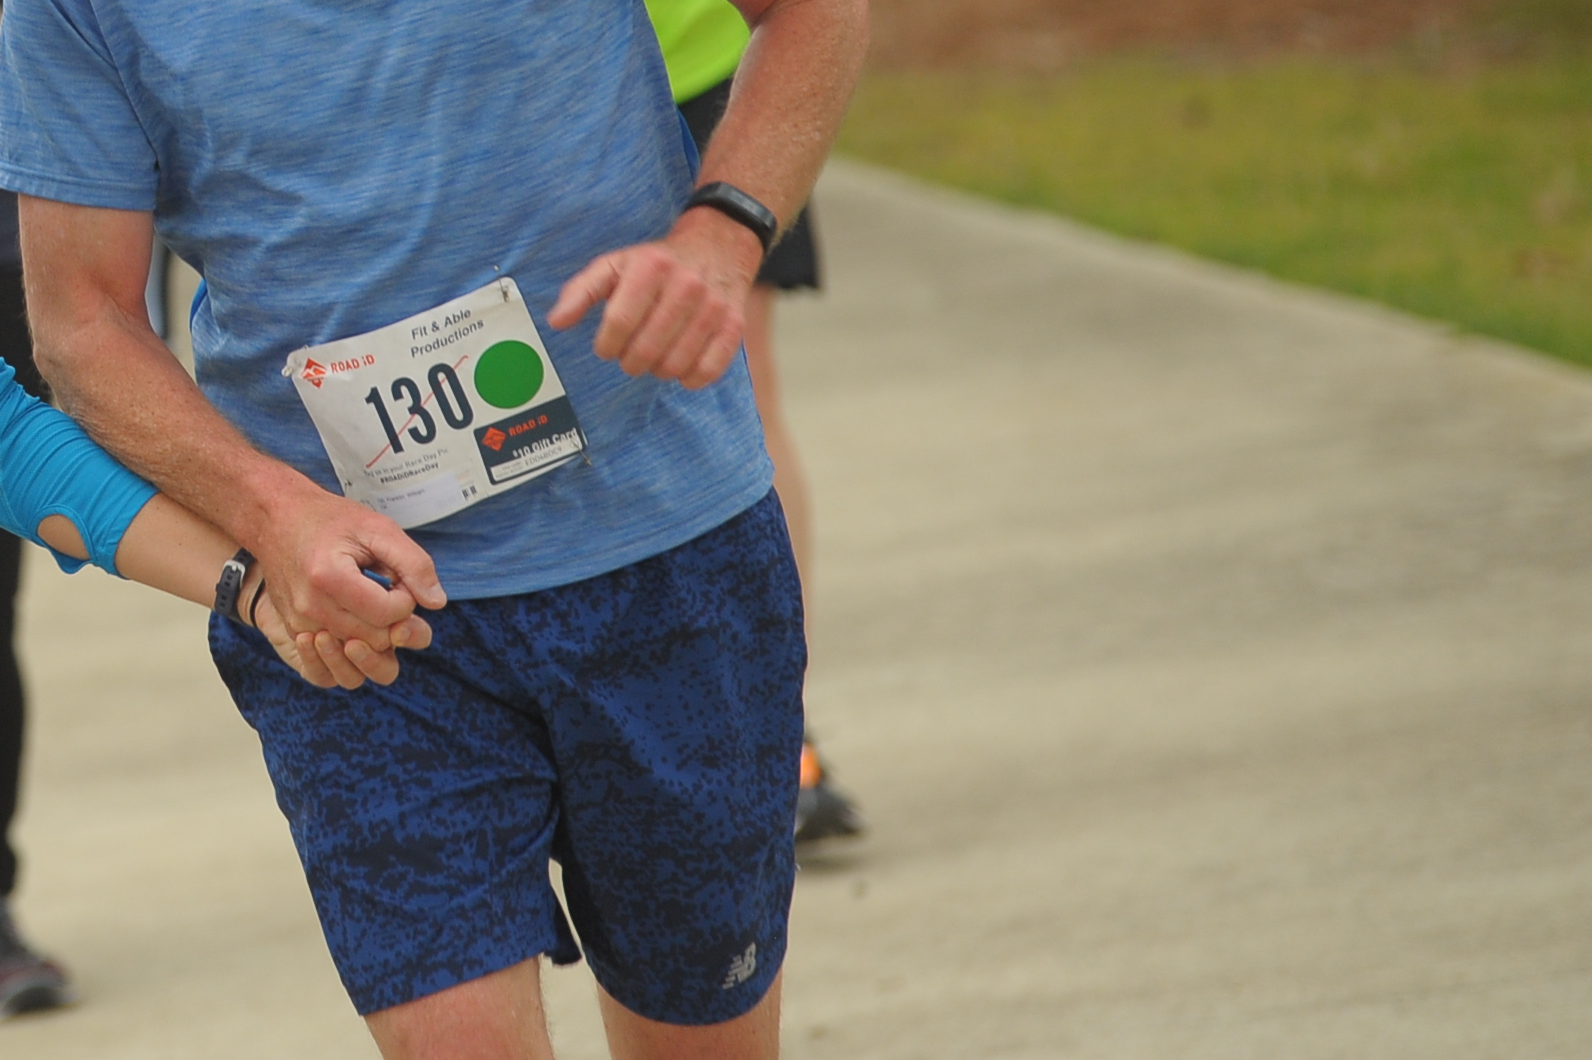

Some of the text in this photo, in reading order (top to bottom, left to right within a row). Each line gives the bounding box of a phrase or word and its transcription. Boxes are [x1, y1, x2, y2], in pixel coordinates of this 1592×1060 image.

[410, 309, 471, 340] Fit & Able
[410, 319, 484, 358] Productions
[330, 358, 360, 374] ROAD
[364, 363, 474, 454] 130
[509, 419, 536, 436] ROAD
[552, 427, 576, 443] Card
